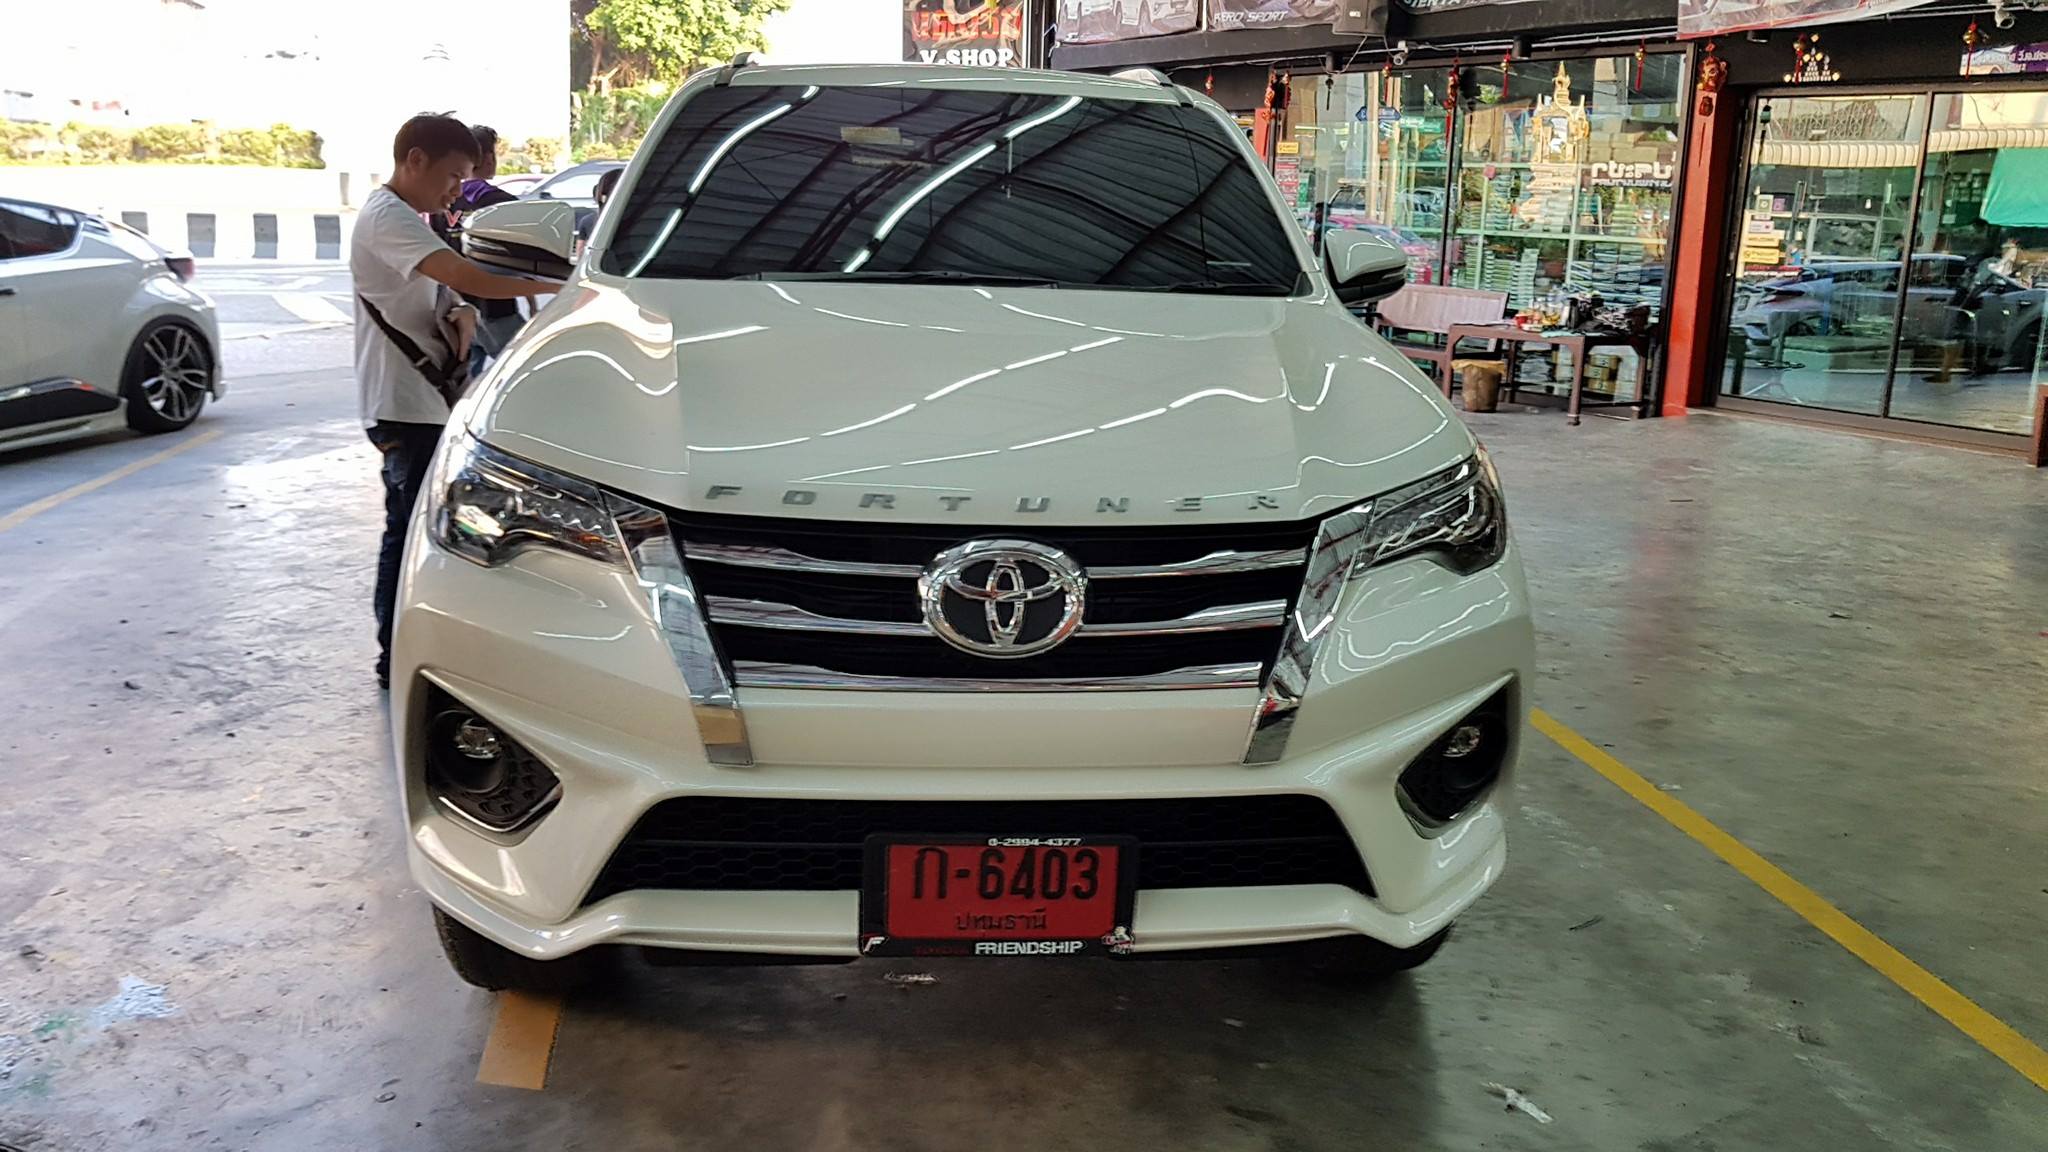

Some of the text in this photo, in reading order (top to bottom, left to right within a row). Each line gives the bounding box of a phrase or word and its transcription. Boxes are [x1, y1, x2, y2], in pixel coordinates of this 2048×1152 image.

[1247, 10, 1289, 22] SPORT
[704, 484, 1280, 513] FORTUNER
[974, 940, 1084, 955] FRIENDSHIP
